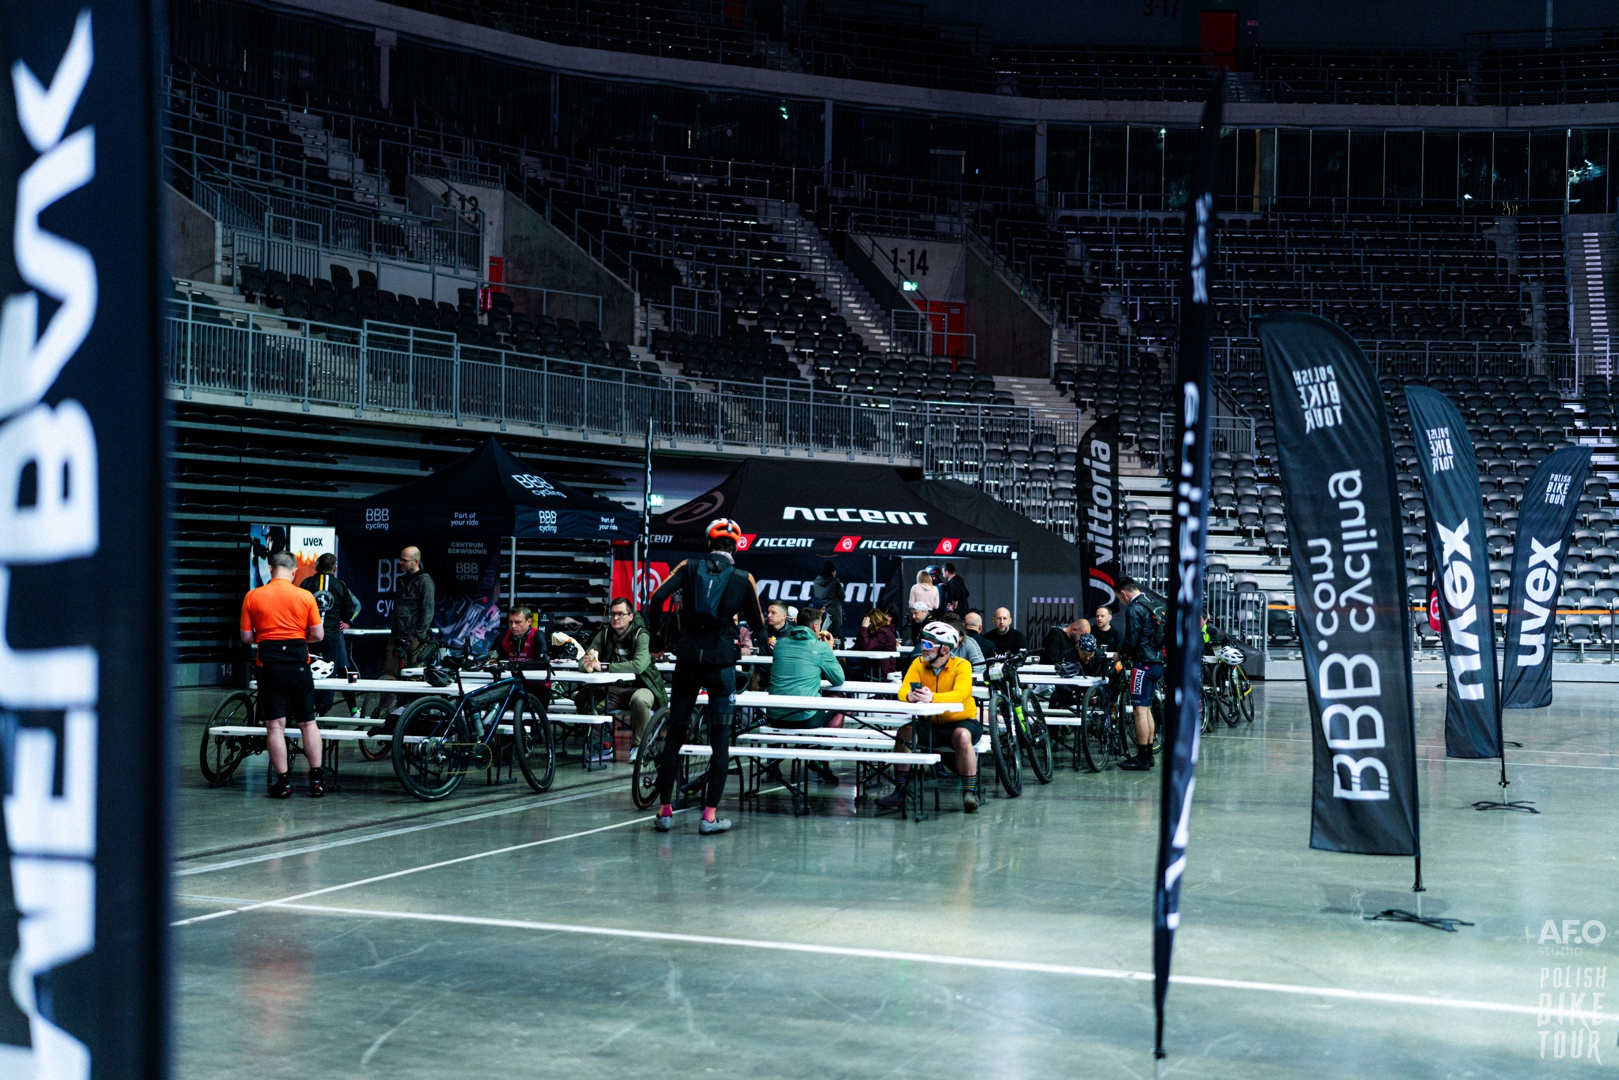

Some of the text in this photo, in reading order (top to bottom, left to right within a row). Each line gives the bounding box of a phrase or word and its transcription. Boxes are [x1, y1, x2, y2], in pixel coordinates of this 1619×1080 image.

[890, 247, 929, 276] 1-14
[511, 473, 555, 490] BBB
[1550, 473, 1572, 483] POLISH
[1546, 481, 1570, 495] BIKE
[1544, 493, 1566, 507] TOUR
[365, 507, 390, 522] BBB
[454, 511, 477, 519] Part of
[538, 510, 557, 525] BBB
[365, 522, 390, 531] cycling
[450, 519, 465, 527] your
[303, 537, 324, 547] uvex
[451, 541, 485, 549] CENTRUM
[455, 561, 479, 574] BBB
[1517, 536, 1563, 667] uvex
[220, 663, 233, 677] 14
[1134, 670, 1145, 695] SOUDAL
